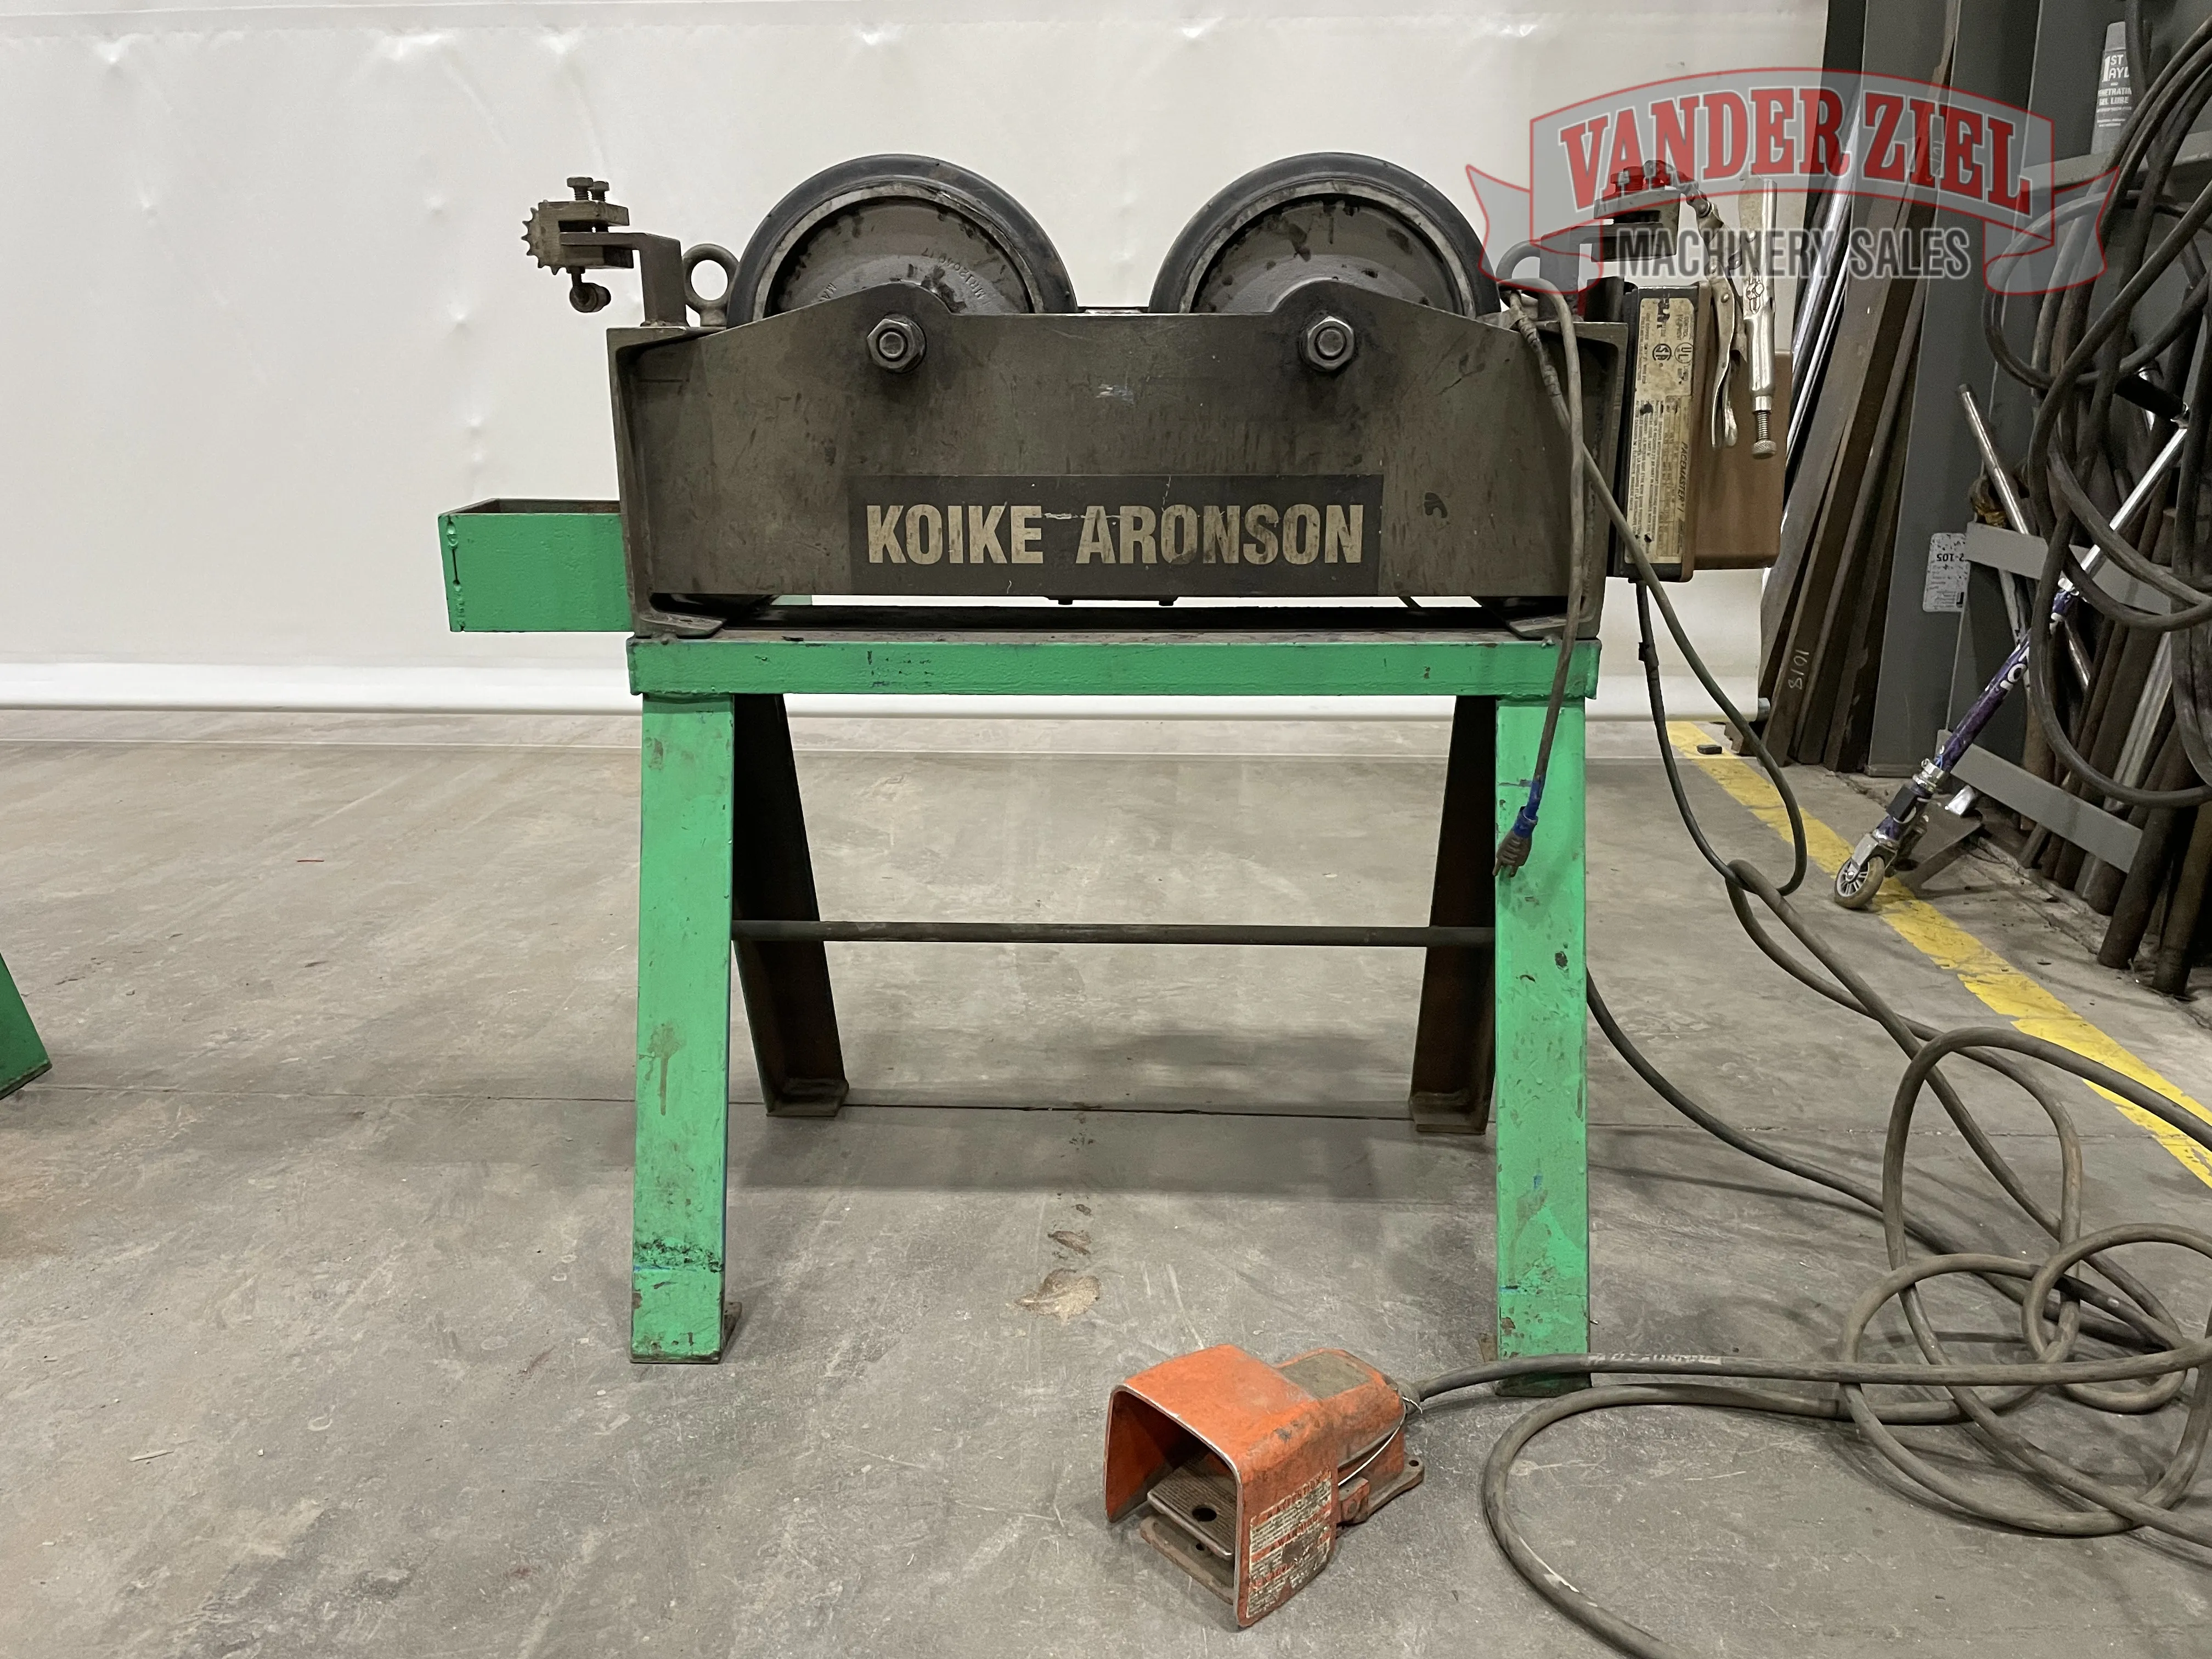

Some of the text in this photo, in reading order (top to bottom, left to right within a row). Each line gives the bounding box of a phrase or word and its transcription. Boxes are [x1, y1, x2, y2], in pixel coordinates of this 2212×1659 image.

[1678, 441, 1688, 503] PACEMASTER
[866, 504, 1363, 565] KOIKE ARONSON
